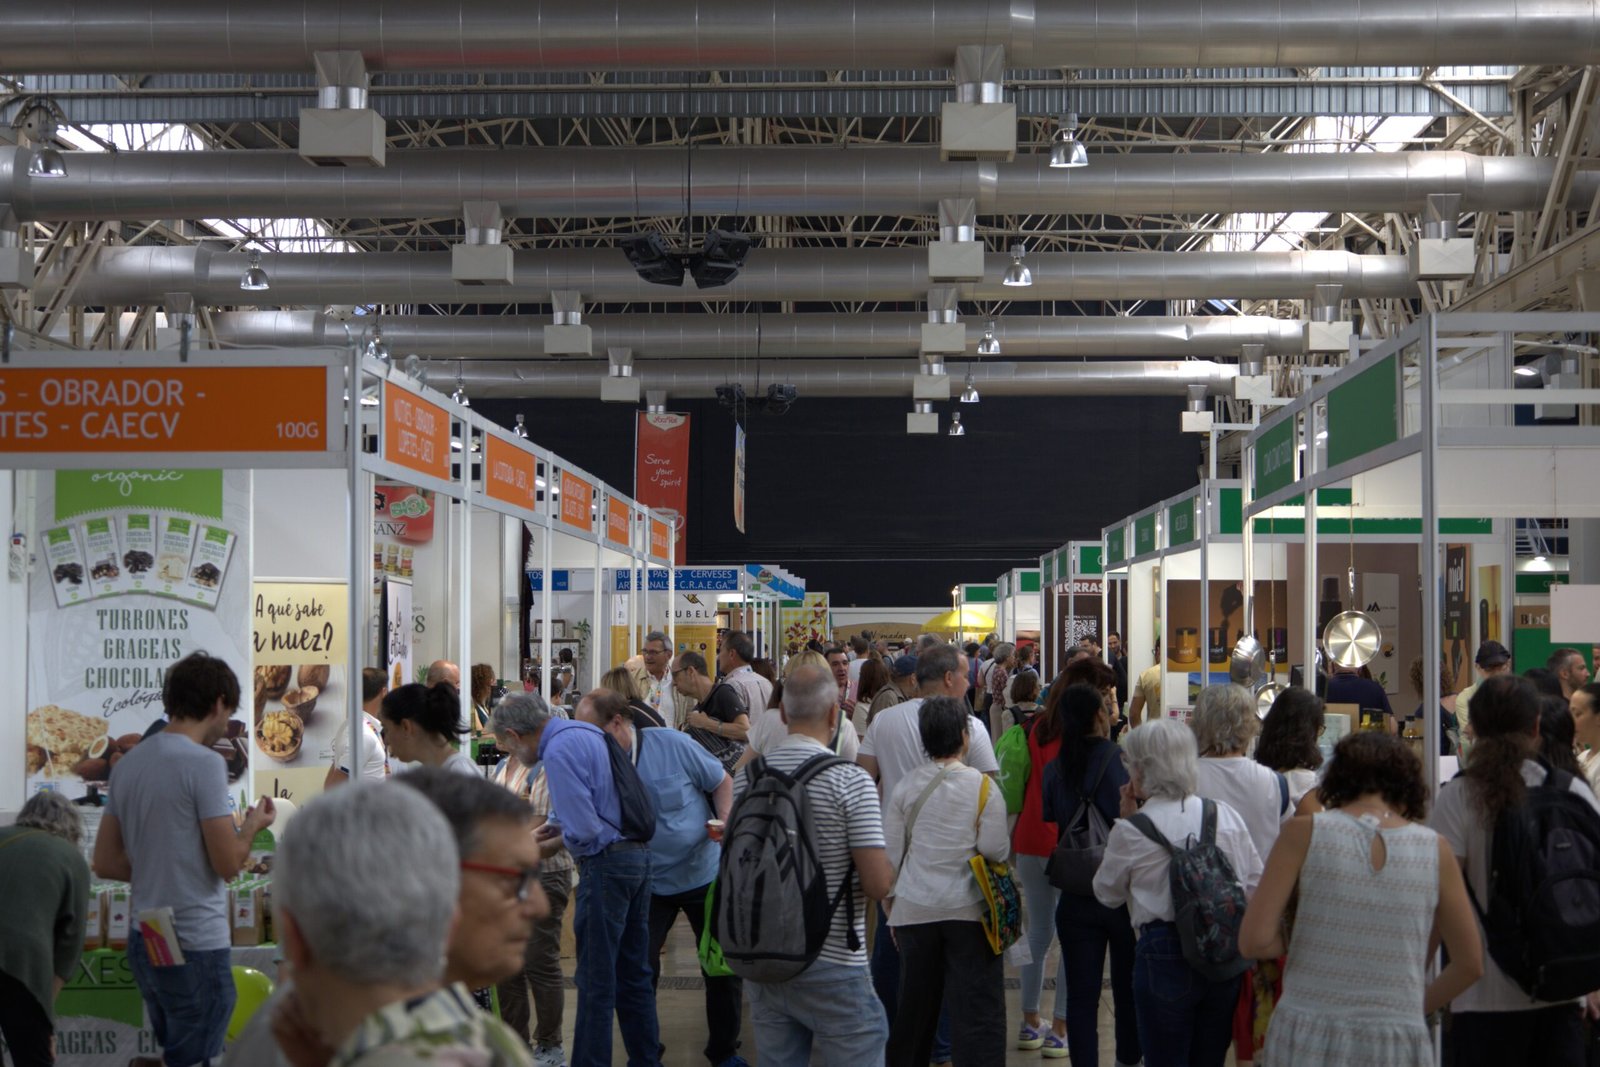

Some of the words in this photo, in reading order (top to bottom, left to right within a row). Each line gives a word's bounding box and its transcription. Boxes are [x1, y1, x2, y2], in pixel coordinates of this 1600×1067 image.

[40, 378, 185, 407] OBRADOR
[80, 411, 181, 439] CAECV
[276, 422, 319, 439] 100G
[644, 453, 671, 465] Serve
[91, 469, 184, 497] organic
[650, 468, 675, 482] your
[659, 477, 682, 488] spirit
[374, 522, 406, 535] ANZ
[617, 581, 669, 589] ARESNALS
[652, 571, 682, 579] PASES
[690, 571, 732, 579] CERVESES
[1447, 557, 1464, 593] miel
[96, 608, 189, 630] TURRONES
[255, 593, 264, 618] A
[267, 597, 294, 624] qué
[295, 597, 325, 621] sabe
[103, 638, 182, 660] GRAGEAS
[271, 621, 334, 660] nuez?
[274, 777, 293, 800] la
